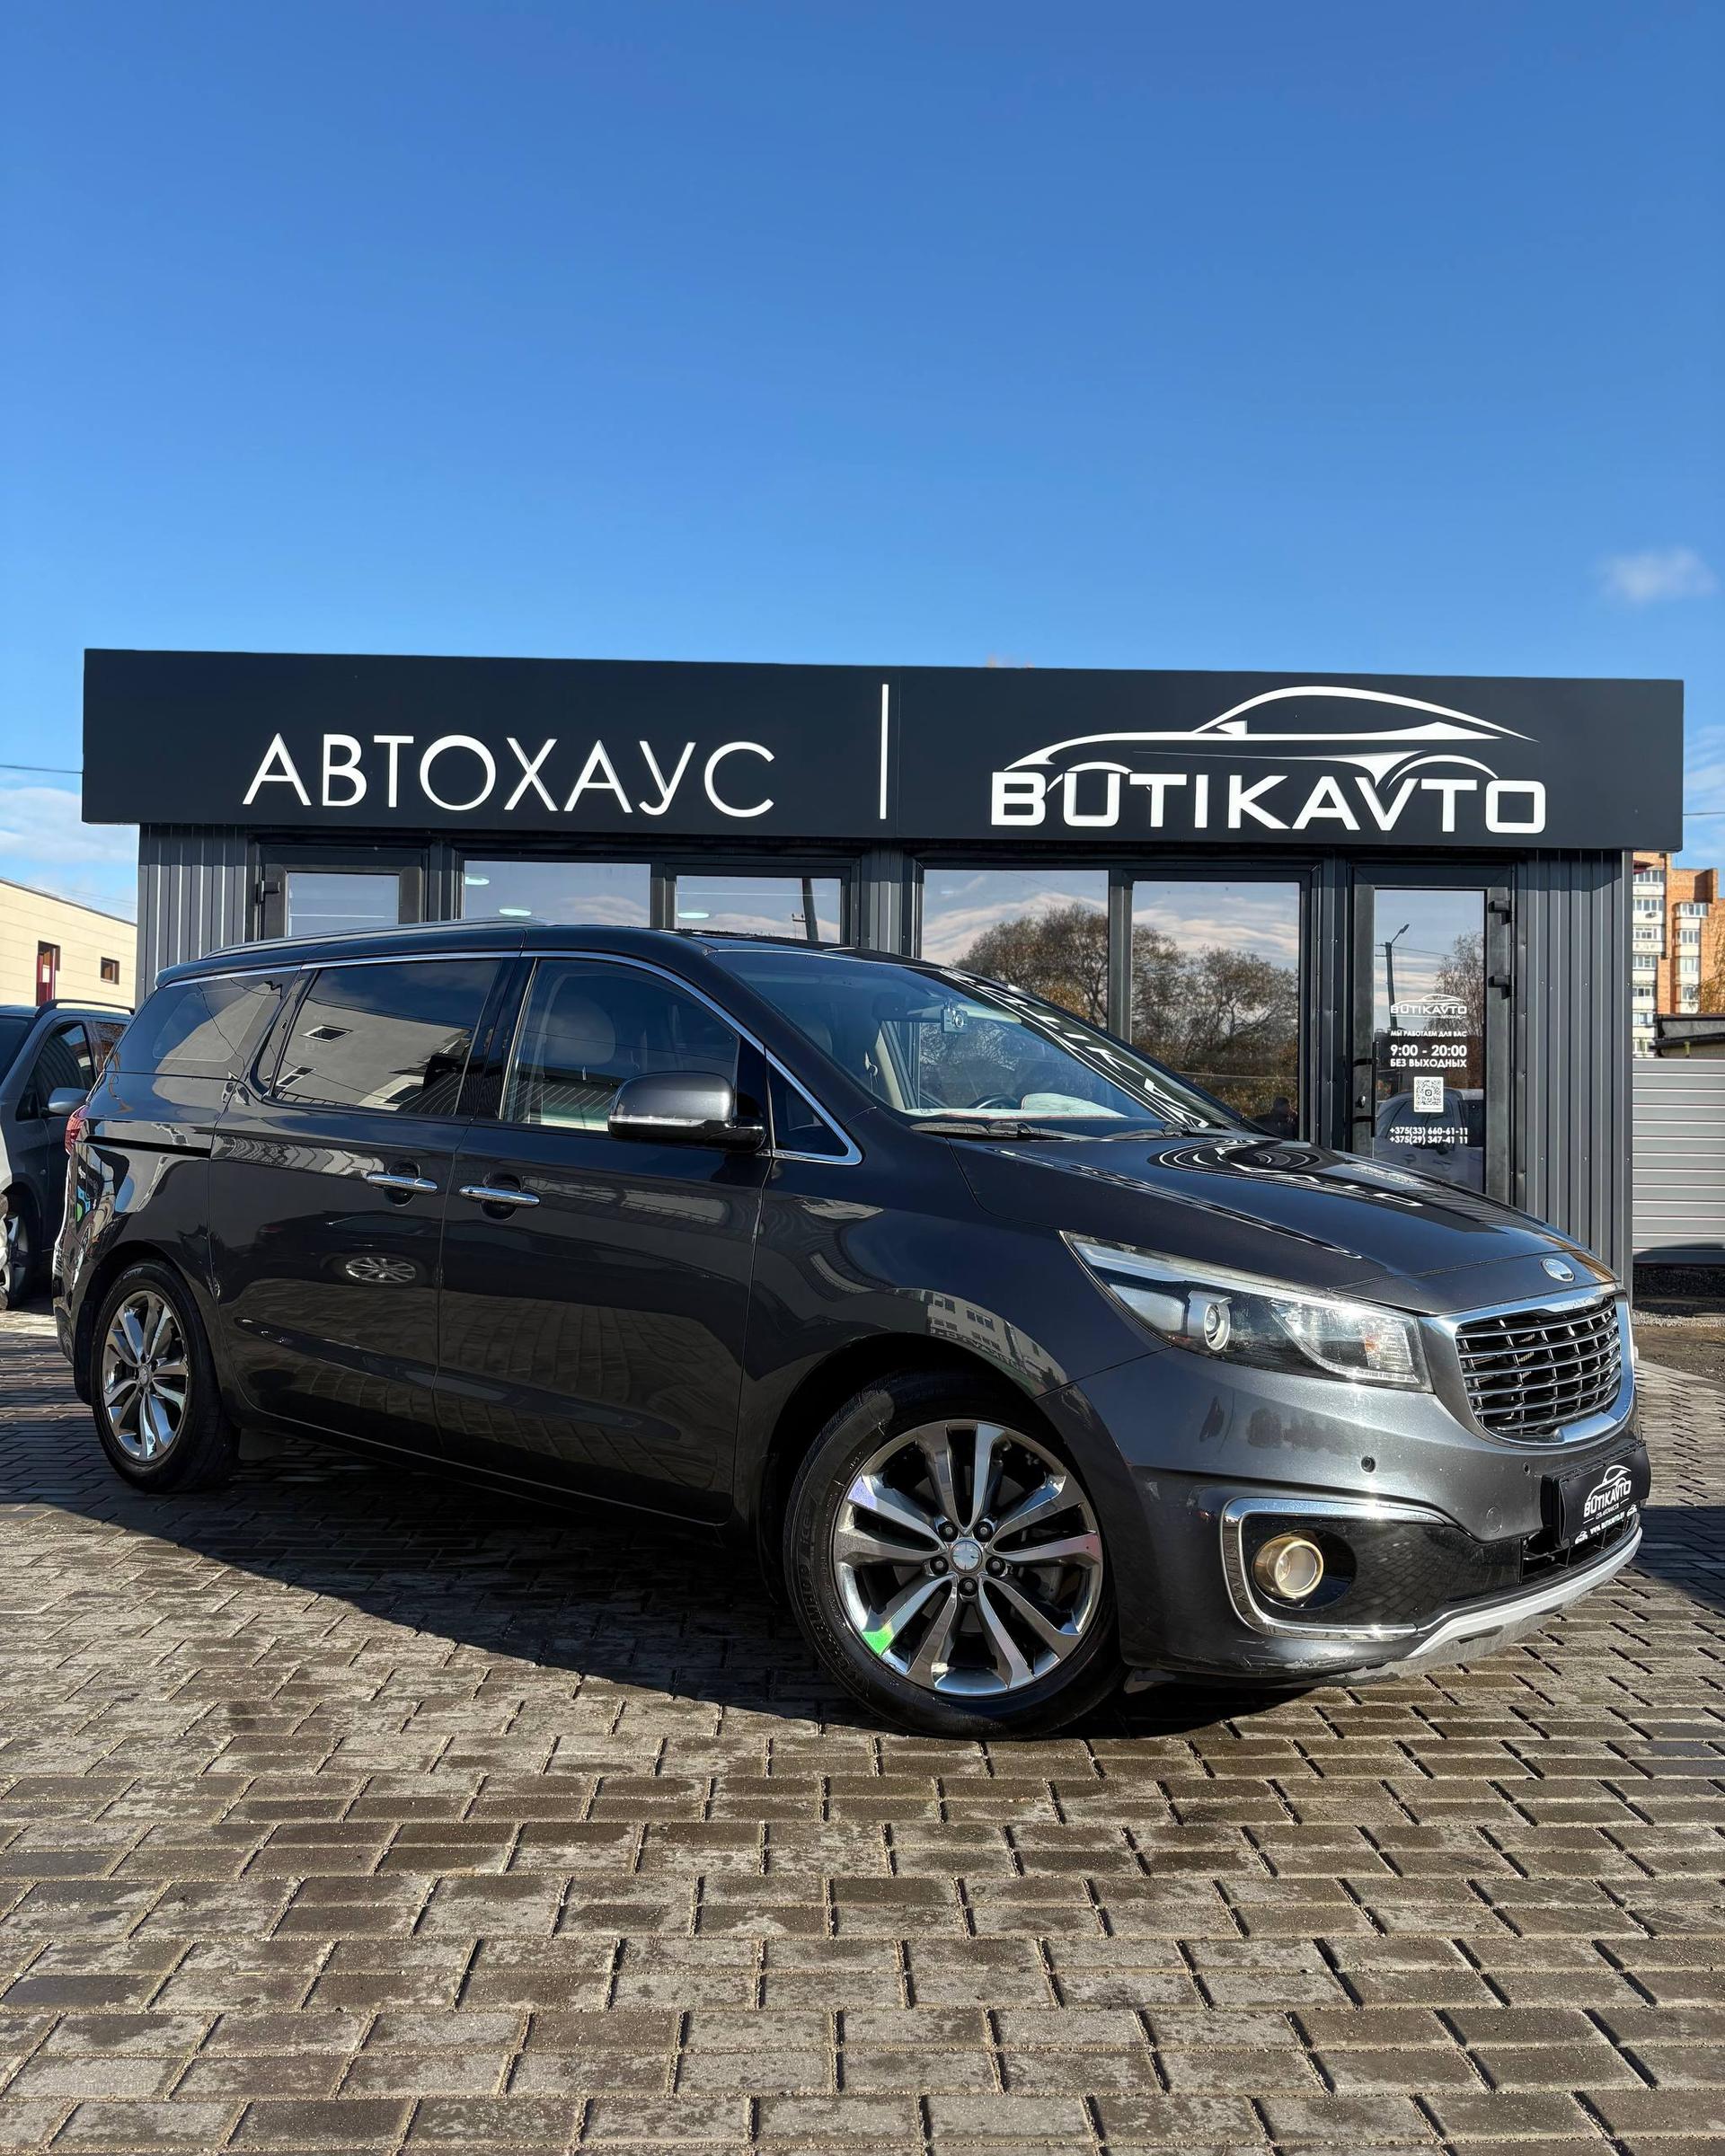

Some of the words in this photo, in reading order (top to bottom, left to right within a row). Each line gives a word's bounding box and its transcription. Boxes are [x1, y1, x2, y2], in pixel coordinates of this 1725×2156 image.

[242, 732, 775, 818] АВТОХАУС
[991, 770, 1547, 834] BUTIKAVTO
[1390, 1004, 1467, 1014] BUTIKAVTO
[1390, 1044, 1419, 1056] 9:00
[1430, 1044, 1467, 1056] 20:00
[1390, 1058, 1407, 1067] БЕЗ
[1408, 1058, 1467, 1068] ВЫХОДНЫХ
[1389, 1127, 1426, 1136] +375(33)
[1427, 1127, 1468, 1135] 660-61-11
[1389, 1135, 1426, 1145] +375(29)
[1583, 1480, 1632, 1518] BUTIKAVTO
